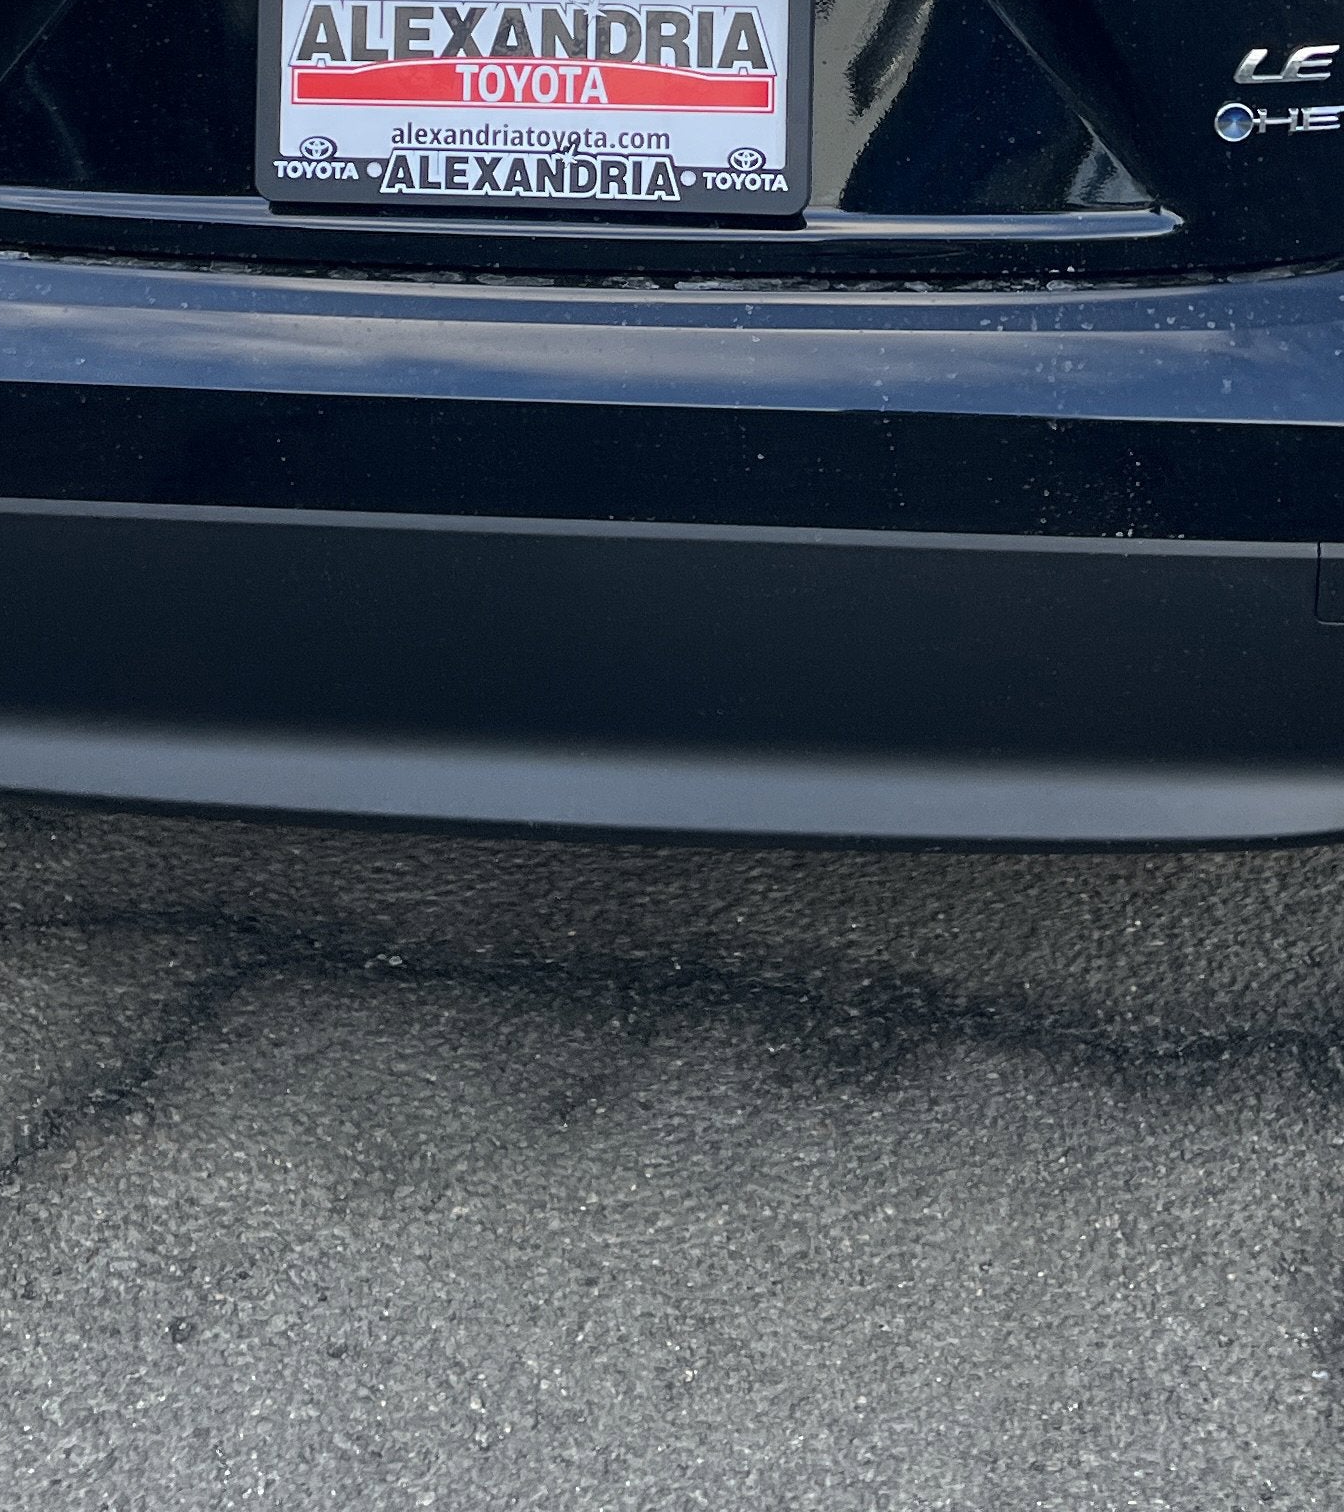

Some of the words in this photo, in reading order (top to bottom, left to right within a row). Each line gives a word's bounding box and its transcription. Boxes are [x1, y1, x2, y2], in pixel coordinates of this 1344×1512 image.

[295, 4, 769, 70] ALEXANDRIA
[455, 64, 609, 105] TOYOTA
[1233, 44, 1340, 85] LE
[391, 121, 671, 152] alexandriatoyota.com
[273, 160, 360, 181] TOYOTA
[384, 153, 676, 198] ALEXANDRIA
[702, 171, 789, 193] TOYOTA
